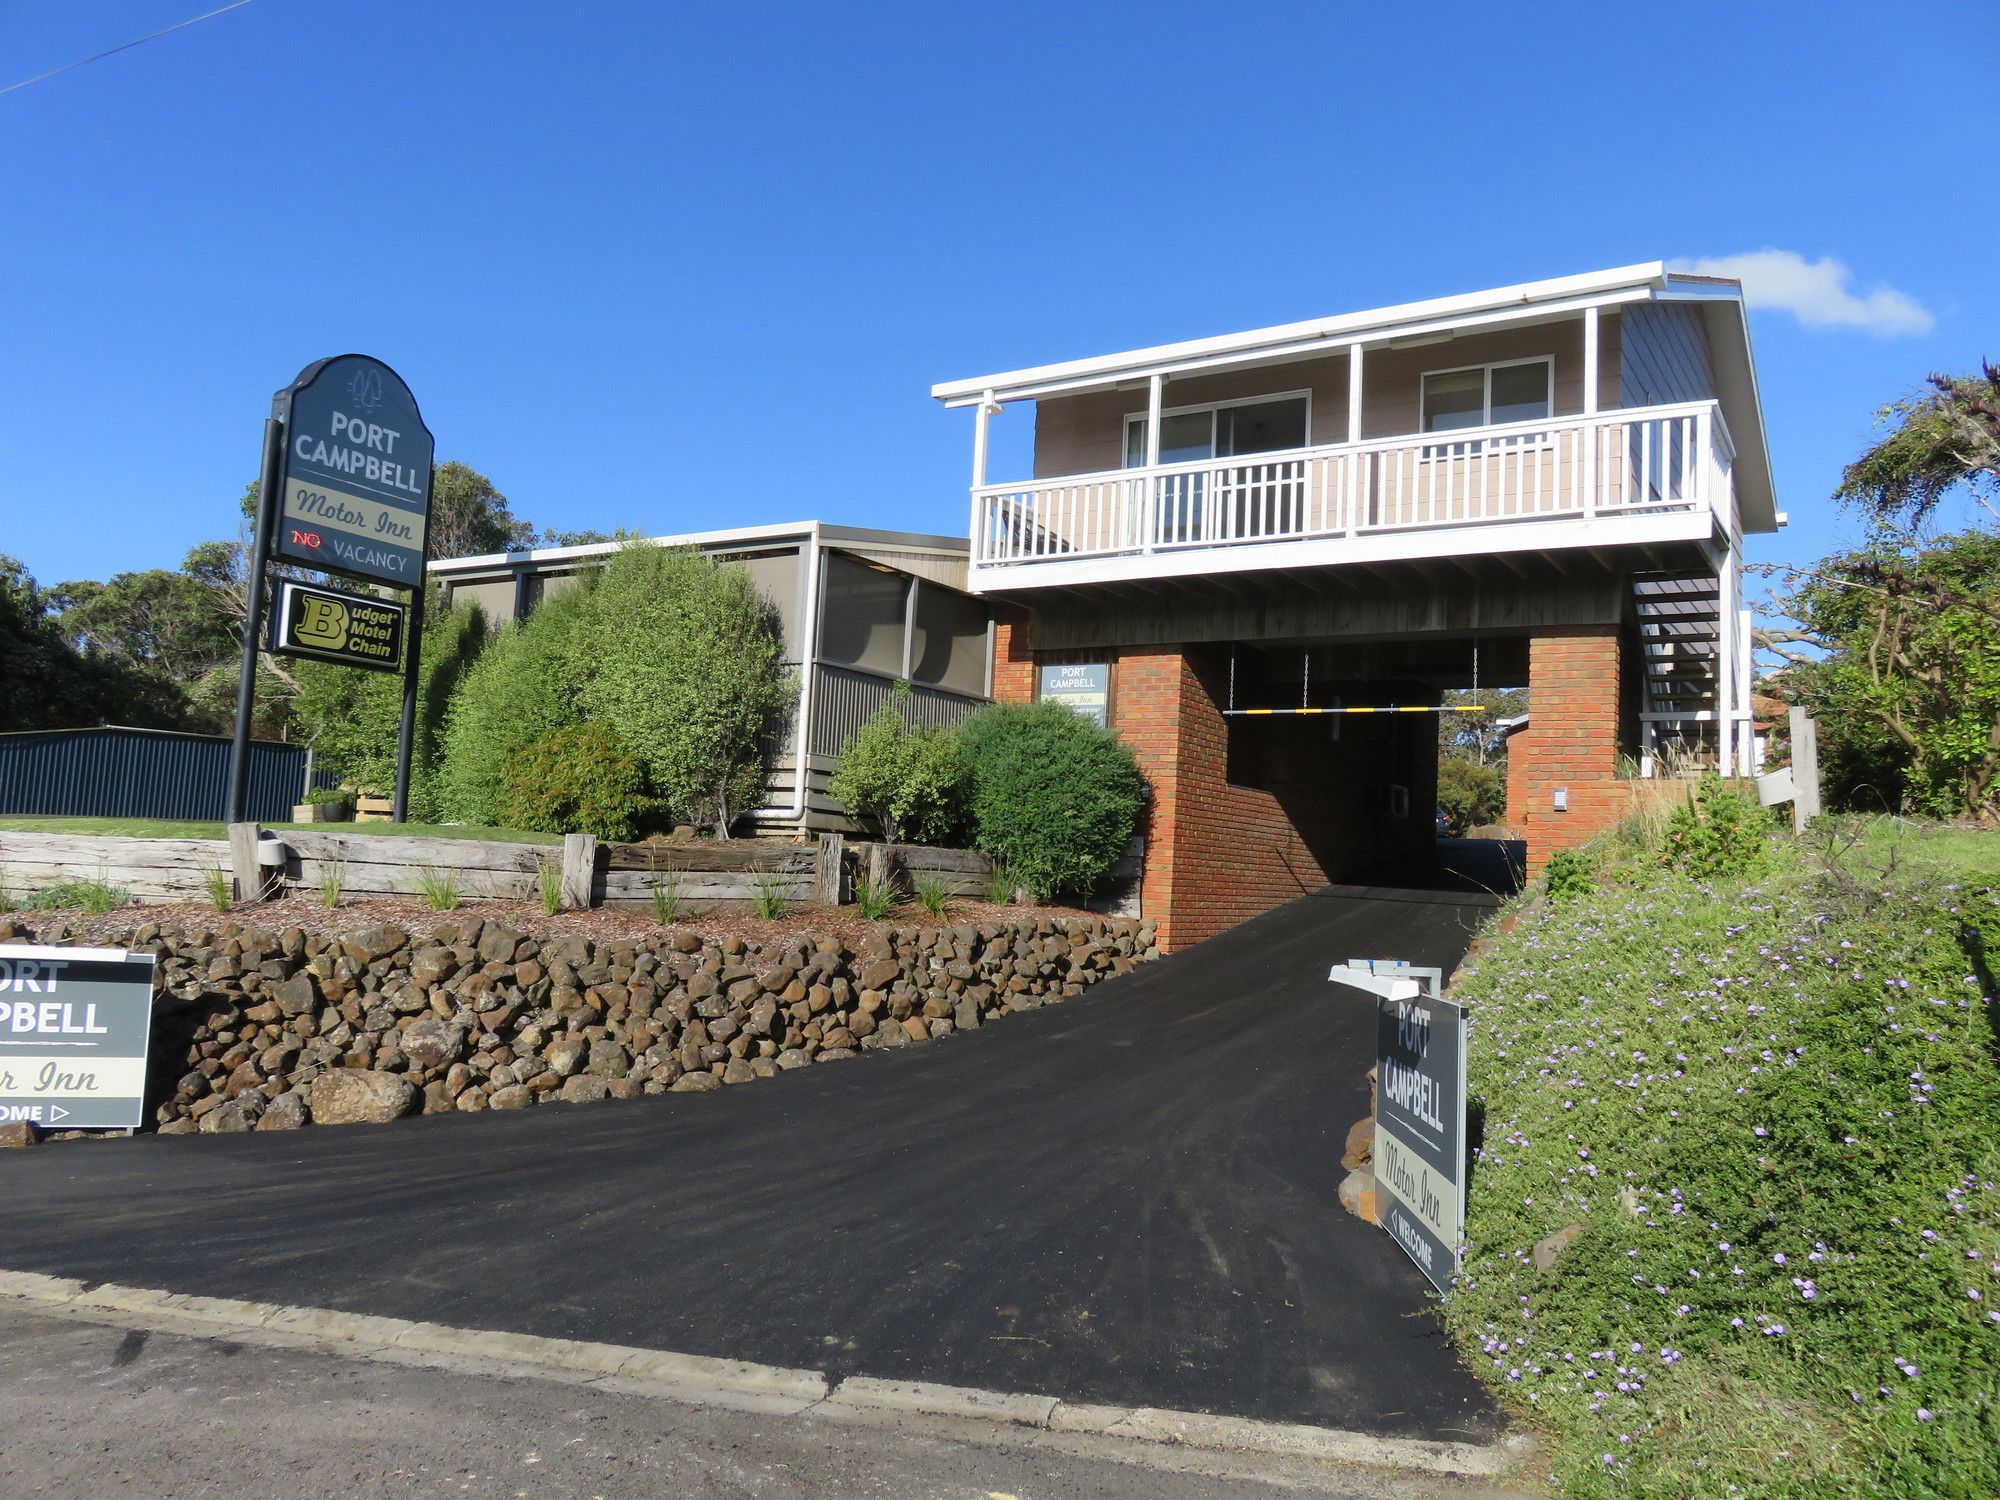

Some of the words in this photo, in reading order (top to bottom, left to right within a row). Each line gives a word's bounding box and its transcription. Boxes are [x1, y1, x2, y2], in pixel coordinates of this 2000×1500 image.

[331, 411, 400, 455] PORT
[295, 434, 422, 494] CAMPBELL
[297, 489, 367, 528] Motor
[374, 511, 413, 540] Inn
[291, 530, 321, 548] NO
[333, 540, 408, 572] VACANCY
[349, 637, 391, 657] Chain
[350, 621, 392, 640] Motel
[1050, 678, 1095, 689] CAMPBELL
[1061, 667, 1087, 677] PORT
[1398, 1001, 1431, 1059] PORT
[33, 1061, 99, 1092] Inn
[1385, 1055, 1444, 1134] CAMPBELL
[1385, 1140, 1417, 1204] Motor
[1419, 1168, 1441, 1228] Inn
[1398, 1214, 1432, 1271] WELCOME
